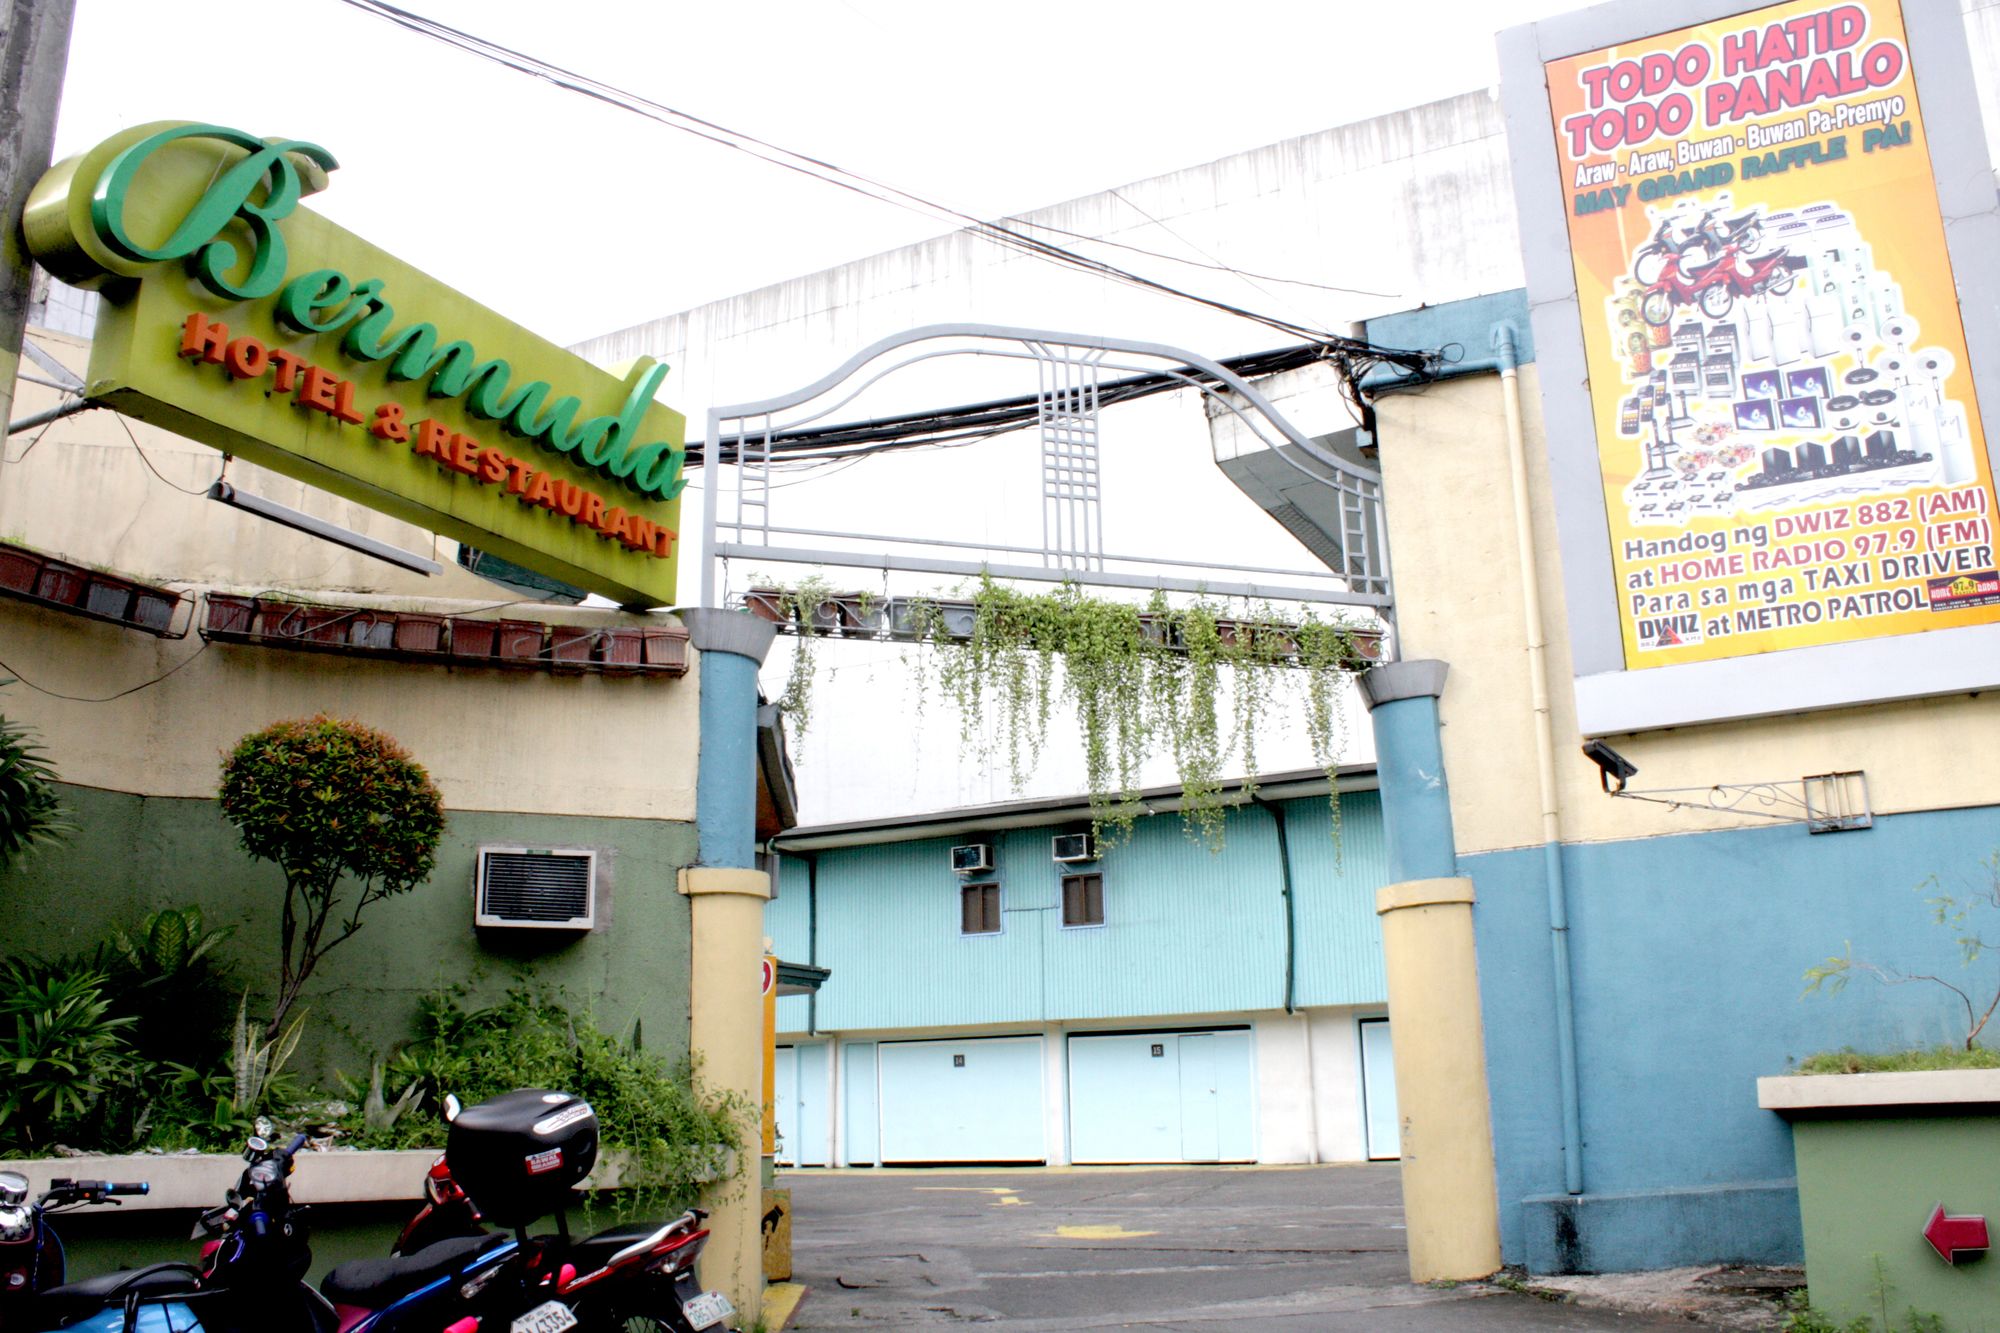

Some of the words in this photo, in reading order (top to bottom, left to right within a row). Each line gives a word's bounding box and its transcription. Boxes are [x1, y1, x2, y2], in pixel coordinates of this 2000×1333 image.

[1565, 93, 1693, 157] TODO
[1706, 42, 1903, 127] PANALO
[1582, 44, 1711, 109] TODO
[1723, 5, 1866, 77] HATID
[1574, 183, 1632, 216] MAY
[1638, 162, 1734, 203] GRAND
[1741, 135, 1847, 180] RAFFLE
[1863, 120, 1912, 153] PA!
[1575, 161, 1616, 188] Araw
[1629, 149, 1675, 176] Araw,
[1677, 135, 1735, 165] Buwan
[1747, 119, 1806, 150] Buwan
[1808, 95, 1905, 136] Pa-Premyo
[92, 124, 690, 501] Bermuda
[181, 312, 365, 425] HOTEL
[371, 401, 411, 443] &
[416, 418, 678, 559] RESTAURANT
[1625, 532, 1726, 560] Handog
[1734, 525, 1767, 547] ng
[1775, 508, 1849, 537] DWIZ
[1858, 499, 1909, 525] 882
[1919, 488, 1986, 522] (AM)
[1628, 569, 1653, 588] at
[1661, 554, 1744, 584] HOME
[1753, 540, 1845, 571] RADIO
[1854, 529, 1916, 556] 97.9
[1926, 519, 1989, 551] (FM)
[1633, 592, 1690, 615] Para
[1701, 587, 1727, 606] sa
[1739, 578, 1793, 603] mga
[1803, 562, 1870, 590] TAXI
[1882, 545, 1992, 580] DRIVER
[1639, 614, 1699, 639] DWIZ
[1707, 615, 1730, 636] at
[1737, 601, 1821, 632] METRO
[1828, 587, 1928, 619] PATROL
